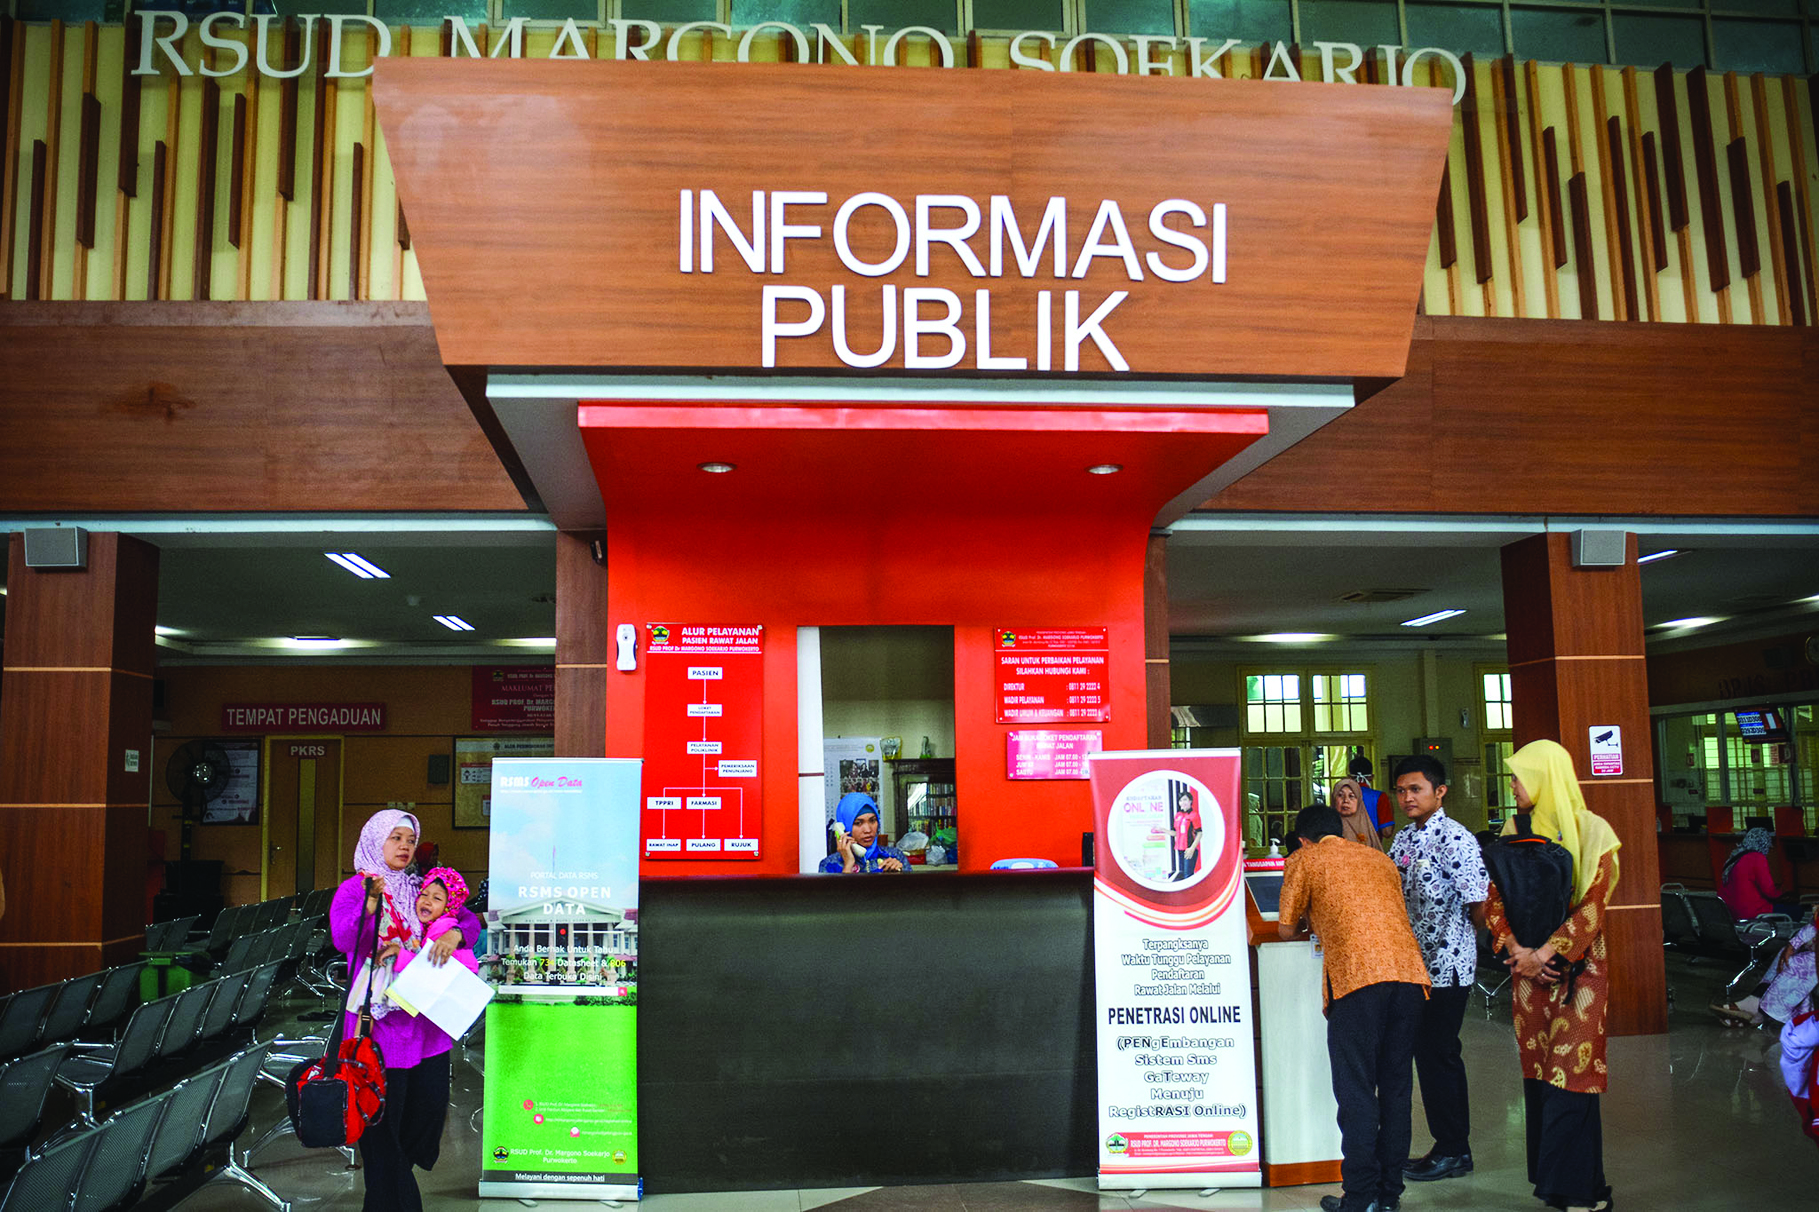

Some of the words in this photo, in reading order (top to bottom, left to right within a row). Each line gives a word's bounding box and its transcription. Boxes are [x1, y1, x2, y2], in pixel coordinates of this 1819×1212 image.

[131, 9, 392, 78] RSUD
[679, 188, 1227, 284] INFORMASI
[761, 284, 1130, 372] PUBLIK
[682, 628, 705, 636] ALUR
[707, 627, 759, 636] PELAYANAN
[1001, 656, 1020, 664] SARAN
[227, 708, 284, 726] TEMPAT
[288, 708, 380, 726] PENGADUAN
[290, 746, 325, 756] PKRS
[500, 776, 529, 787] RSMS
[531, 776, 554, 789] Open
[558, 776, 582, 788] Data
[530, 872, 556, 880] PORTAL
[559, 872, 578, 880] DATA
[578, 872, 598, 880] RSMS
[518, 886, 563, 898] RSMS
[567, 886, 611, 899] OPEN
[543, 902, 586, 916] DATA
[513, 944, 534, 954] Anda
[567, 945, 591, 954] Untuk
[594, 945, 614, 954] Tahu
[502, 958, 538, 966] Temukan
[558, 958, 599, 968] Datasheet
[601, 959, 608, 967] &
[1121, 954, 1150, 966] Waktu
[1151, 954, 1185, 968] Tunggu
[1186, 952, 1232, 966] Pelayanan
[524, 972, 543, 980] Data
[546, 972, 578, 981] Terbuka
[1151, 968, 1205, 980] Pendaftaran
[1134, 984, 1164, 996] Rawat
[1164, 983, 1188, 996] Jalan
[1188, 982, 1222, 995] Melalui
[1108, 1006, 1185, 1025] PENETRASI
[1189, 1006, 1241, 1024] ONLINE
[1134, 1054, 1184, 1066] Sistem
[1186, 1053, 1218, 1066] Sms
[1144, 1070, 1210, 1084] GaTeway
[1150, 1087, 1204, 1102] Menuju
[1108, 1105, 1190, 1120] RegistRASI
[1192, 1103, 1247, 1118] Online)
[555, 1150, 582, 1158] Margono
[583, 1150, 610, 1158] Soekarjo
[515, 1173, 542, 1182] Melayani
[544, 1174, 566, 1182] dengan
[566, 1174, 592, 1182] sepenuh
[592, 1174, 605, 1182] hati
